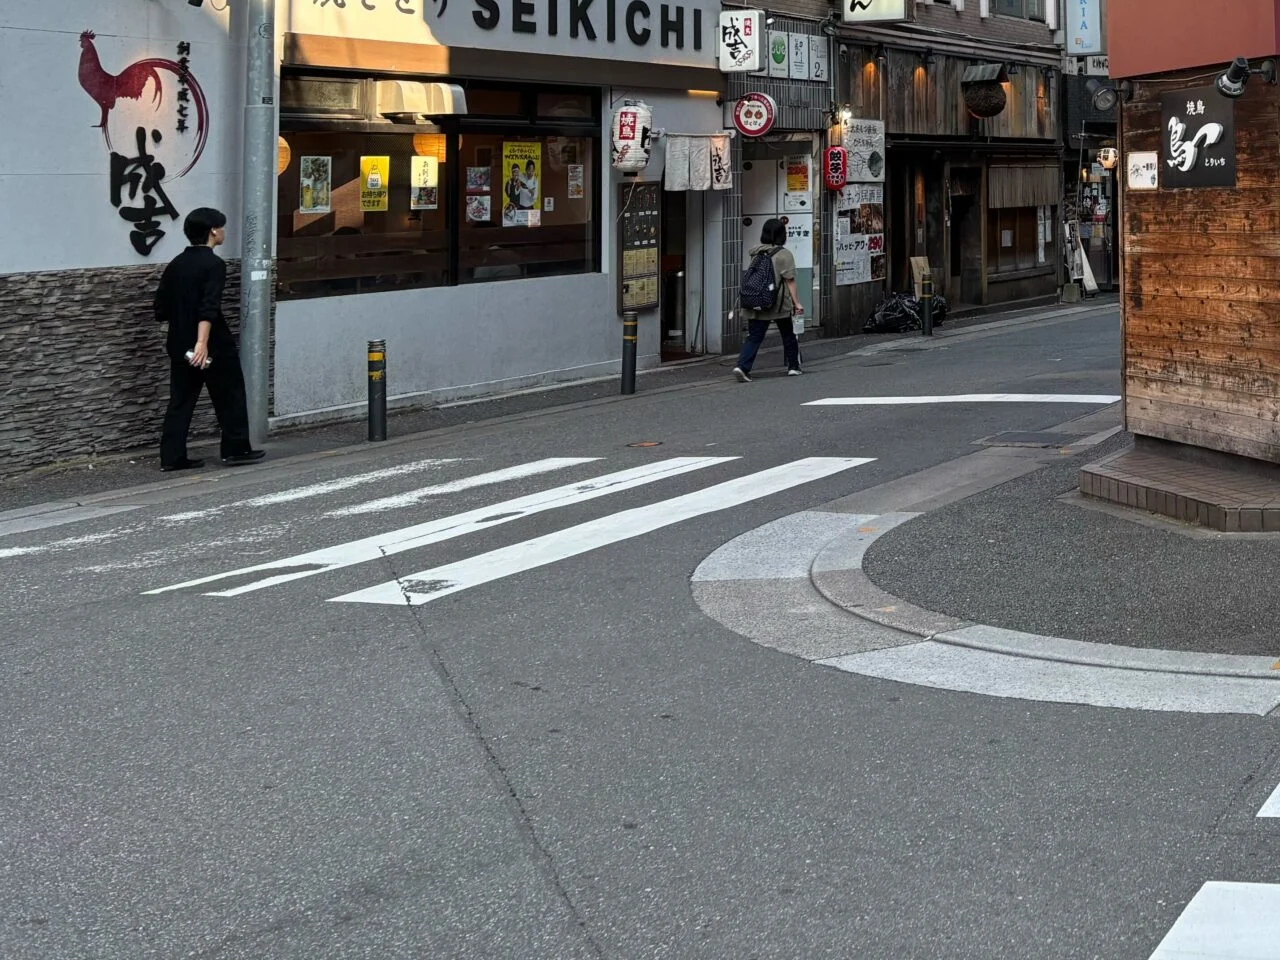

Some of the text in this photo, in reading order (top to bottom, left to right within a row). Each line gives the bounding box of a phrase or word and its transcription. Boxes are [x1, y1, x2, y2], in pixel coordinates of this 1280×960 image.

[722, 17, 748, 60] 成吉
[1186, 100, 1205, 115] 焼鳥
[620, 113, 635, 139] 焼鳥
[829, 150, 842, 173] 餃子
[110, 126, 180, 257] 成吉
